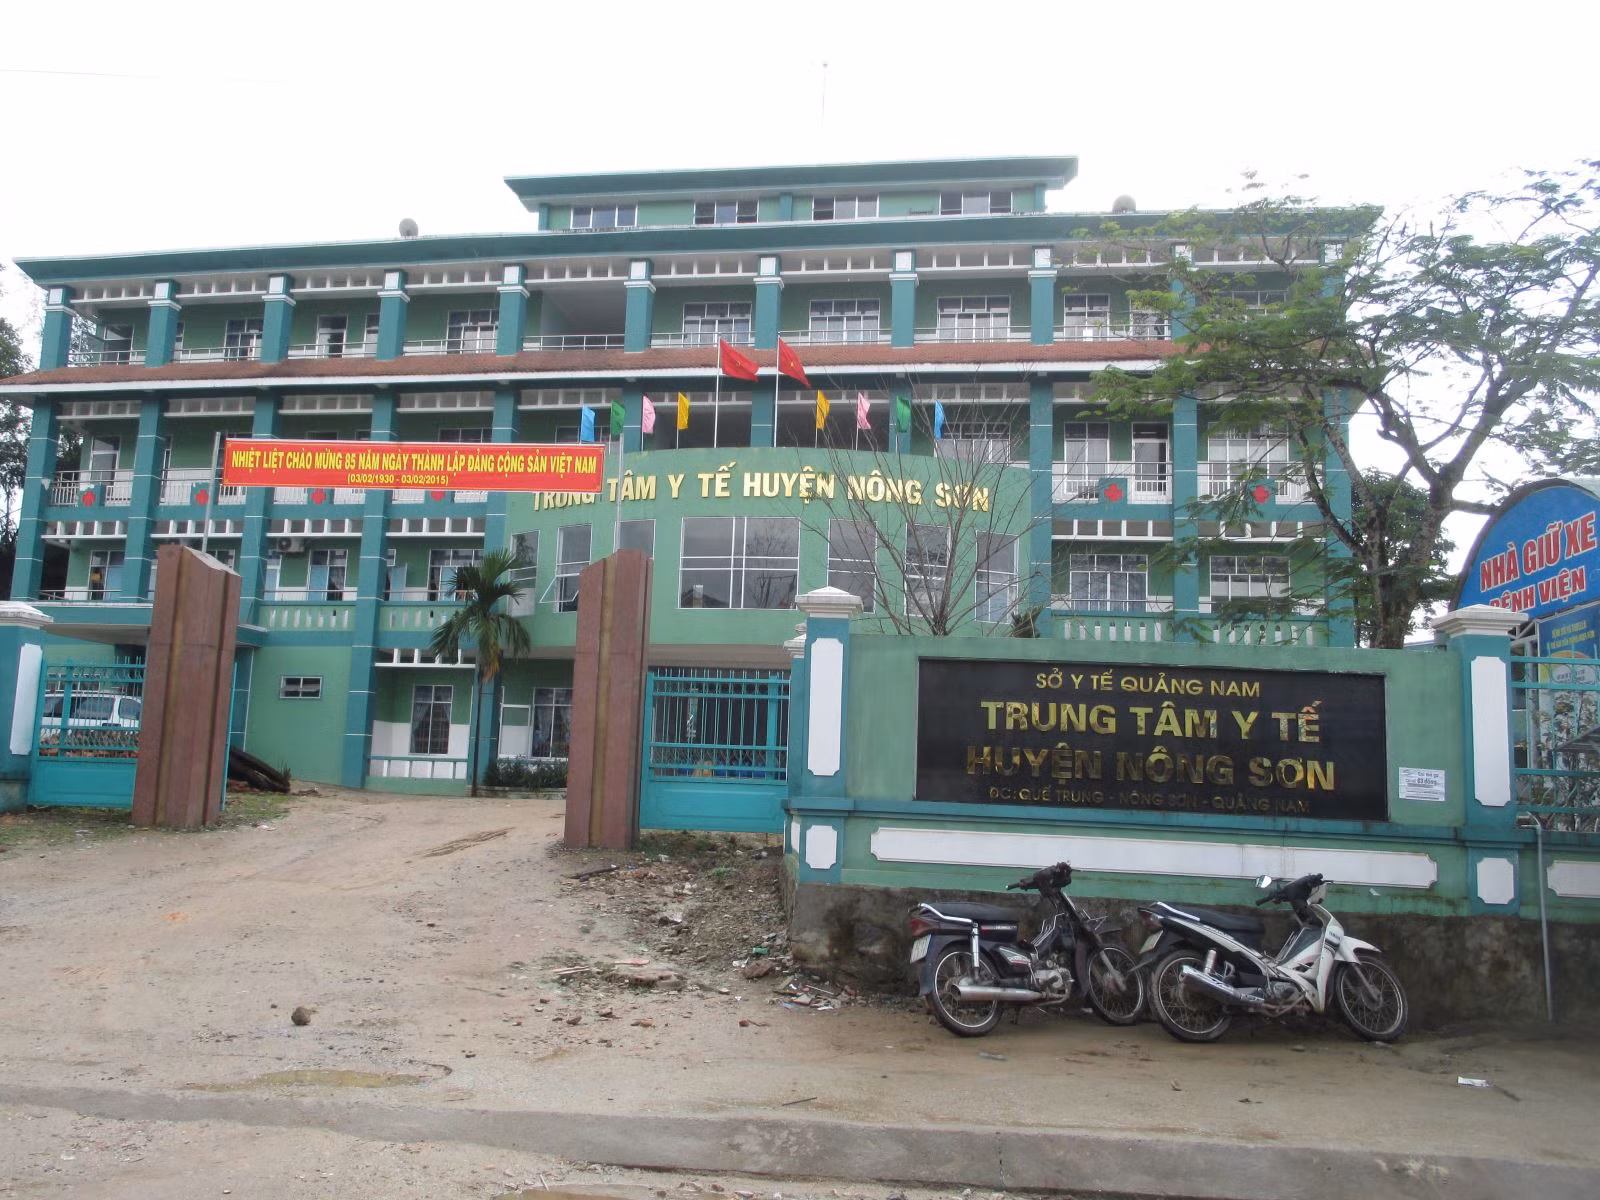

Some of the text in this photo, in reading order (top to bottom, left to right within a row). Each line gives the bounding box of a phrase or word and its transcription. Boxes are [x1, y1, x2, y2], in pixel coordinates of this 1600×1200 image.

[232, 448, 597, 478] NHIỆT LIỆT CHÀO MỪNG 85 NĂM NGÀY THÀNH LẬP ĐẢNG CỘNG SẢN VIỆT NAM
[347, 474, 394, 484] (03/02/1930
[401, 474, 448, 486] 03/02/2015)
[607, 470, 656, 502] TÂM
[668, 474, 685, 498] Y
[698, 461, 736, 498] TẾ
[743, 466, 835, 504] HUYỆN
[848, 470, 922, 505] NÔNG
[1481, 511, 1597, 592] NHÀ GIỮ XE
[1537, 566, 1586, 603] VIỆN
[1036, 667, 1260, 698] SỞ Y TẾ QUẢNG NAM
[981, 700, 1322, 743] TRUNG TÂM Y TẾ
[967, 742, 1336, 791] HUYỆN NÔNG SƠN
[1056, 788, 1103, 803] TRUNG
[1120, 788, 1163, 806] NÔNG
[1212, 793, 1270, 812] QUẢNG
[1275, 798, 1310, 814] NAM
